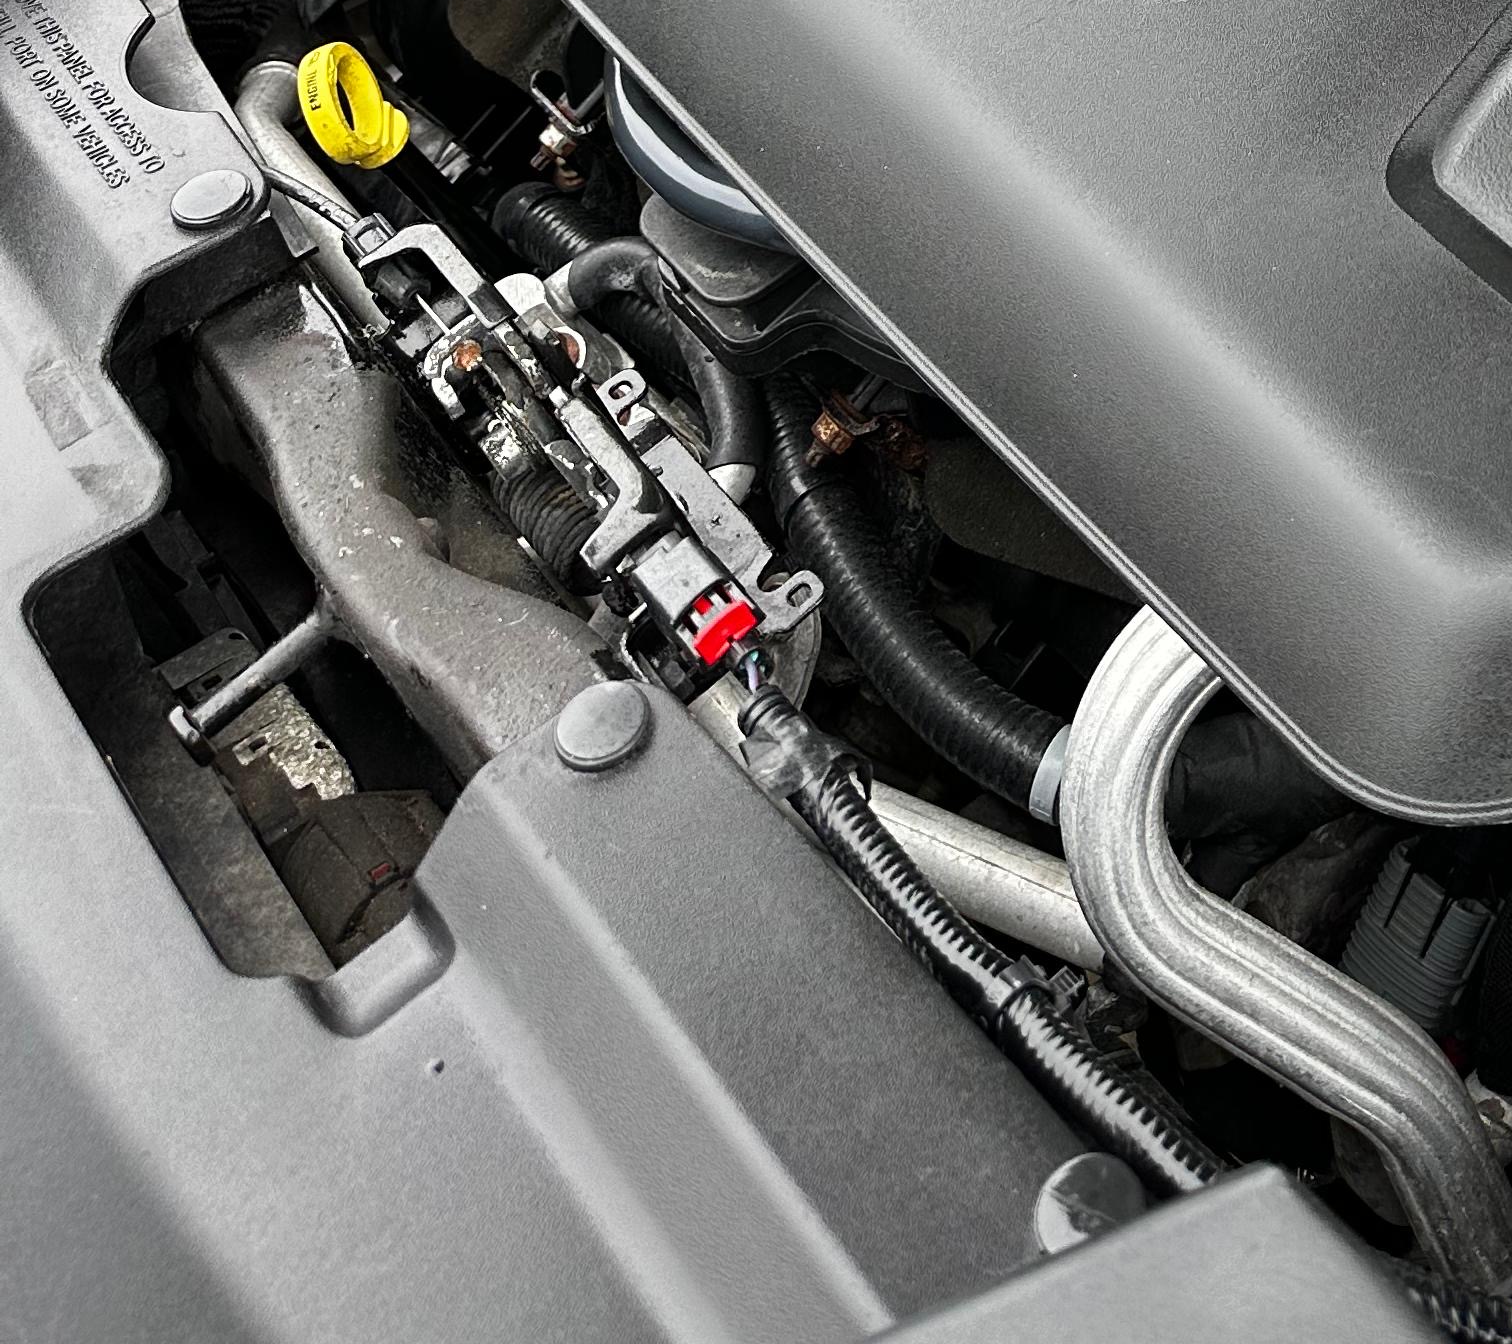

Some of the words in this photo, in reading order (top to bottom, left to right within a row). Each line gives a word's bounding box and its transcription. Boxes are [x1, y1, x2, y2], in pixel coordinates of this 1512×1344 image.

[7, 34, 44, 70] PORT
[30, 67, 60, 93] ON
[45, 88, 87, 130] SOME
[73, 123, 130, 189] VEHICLES
[34, 16, 65, 45] THIS
[52, 40, 95, 85] PANEL
[82, 79, 116, 110] FOR
[102, 106, 151, 157] ACCESS
[138, 151, 166, 174] TO
